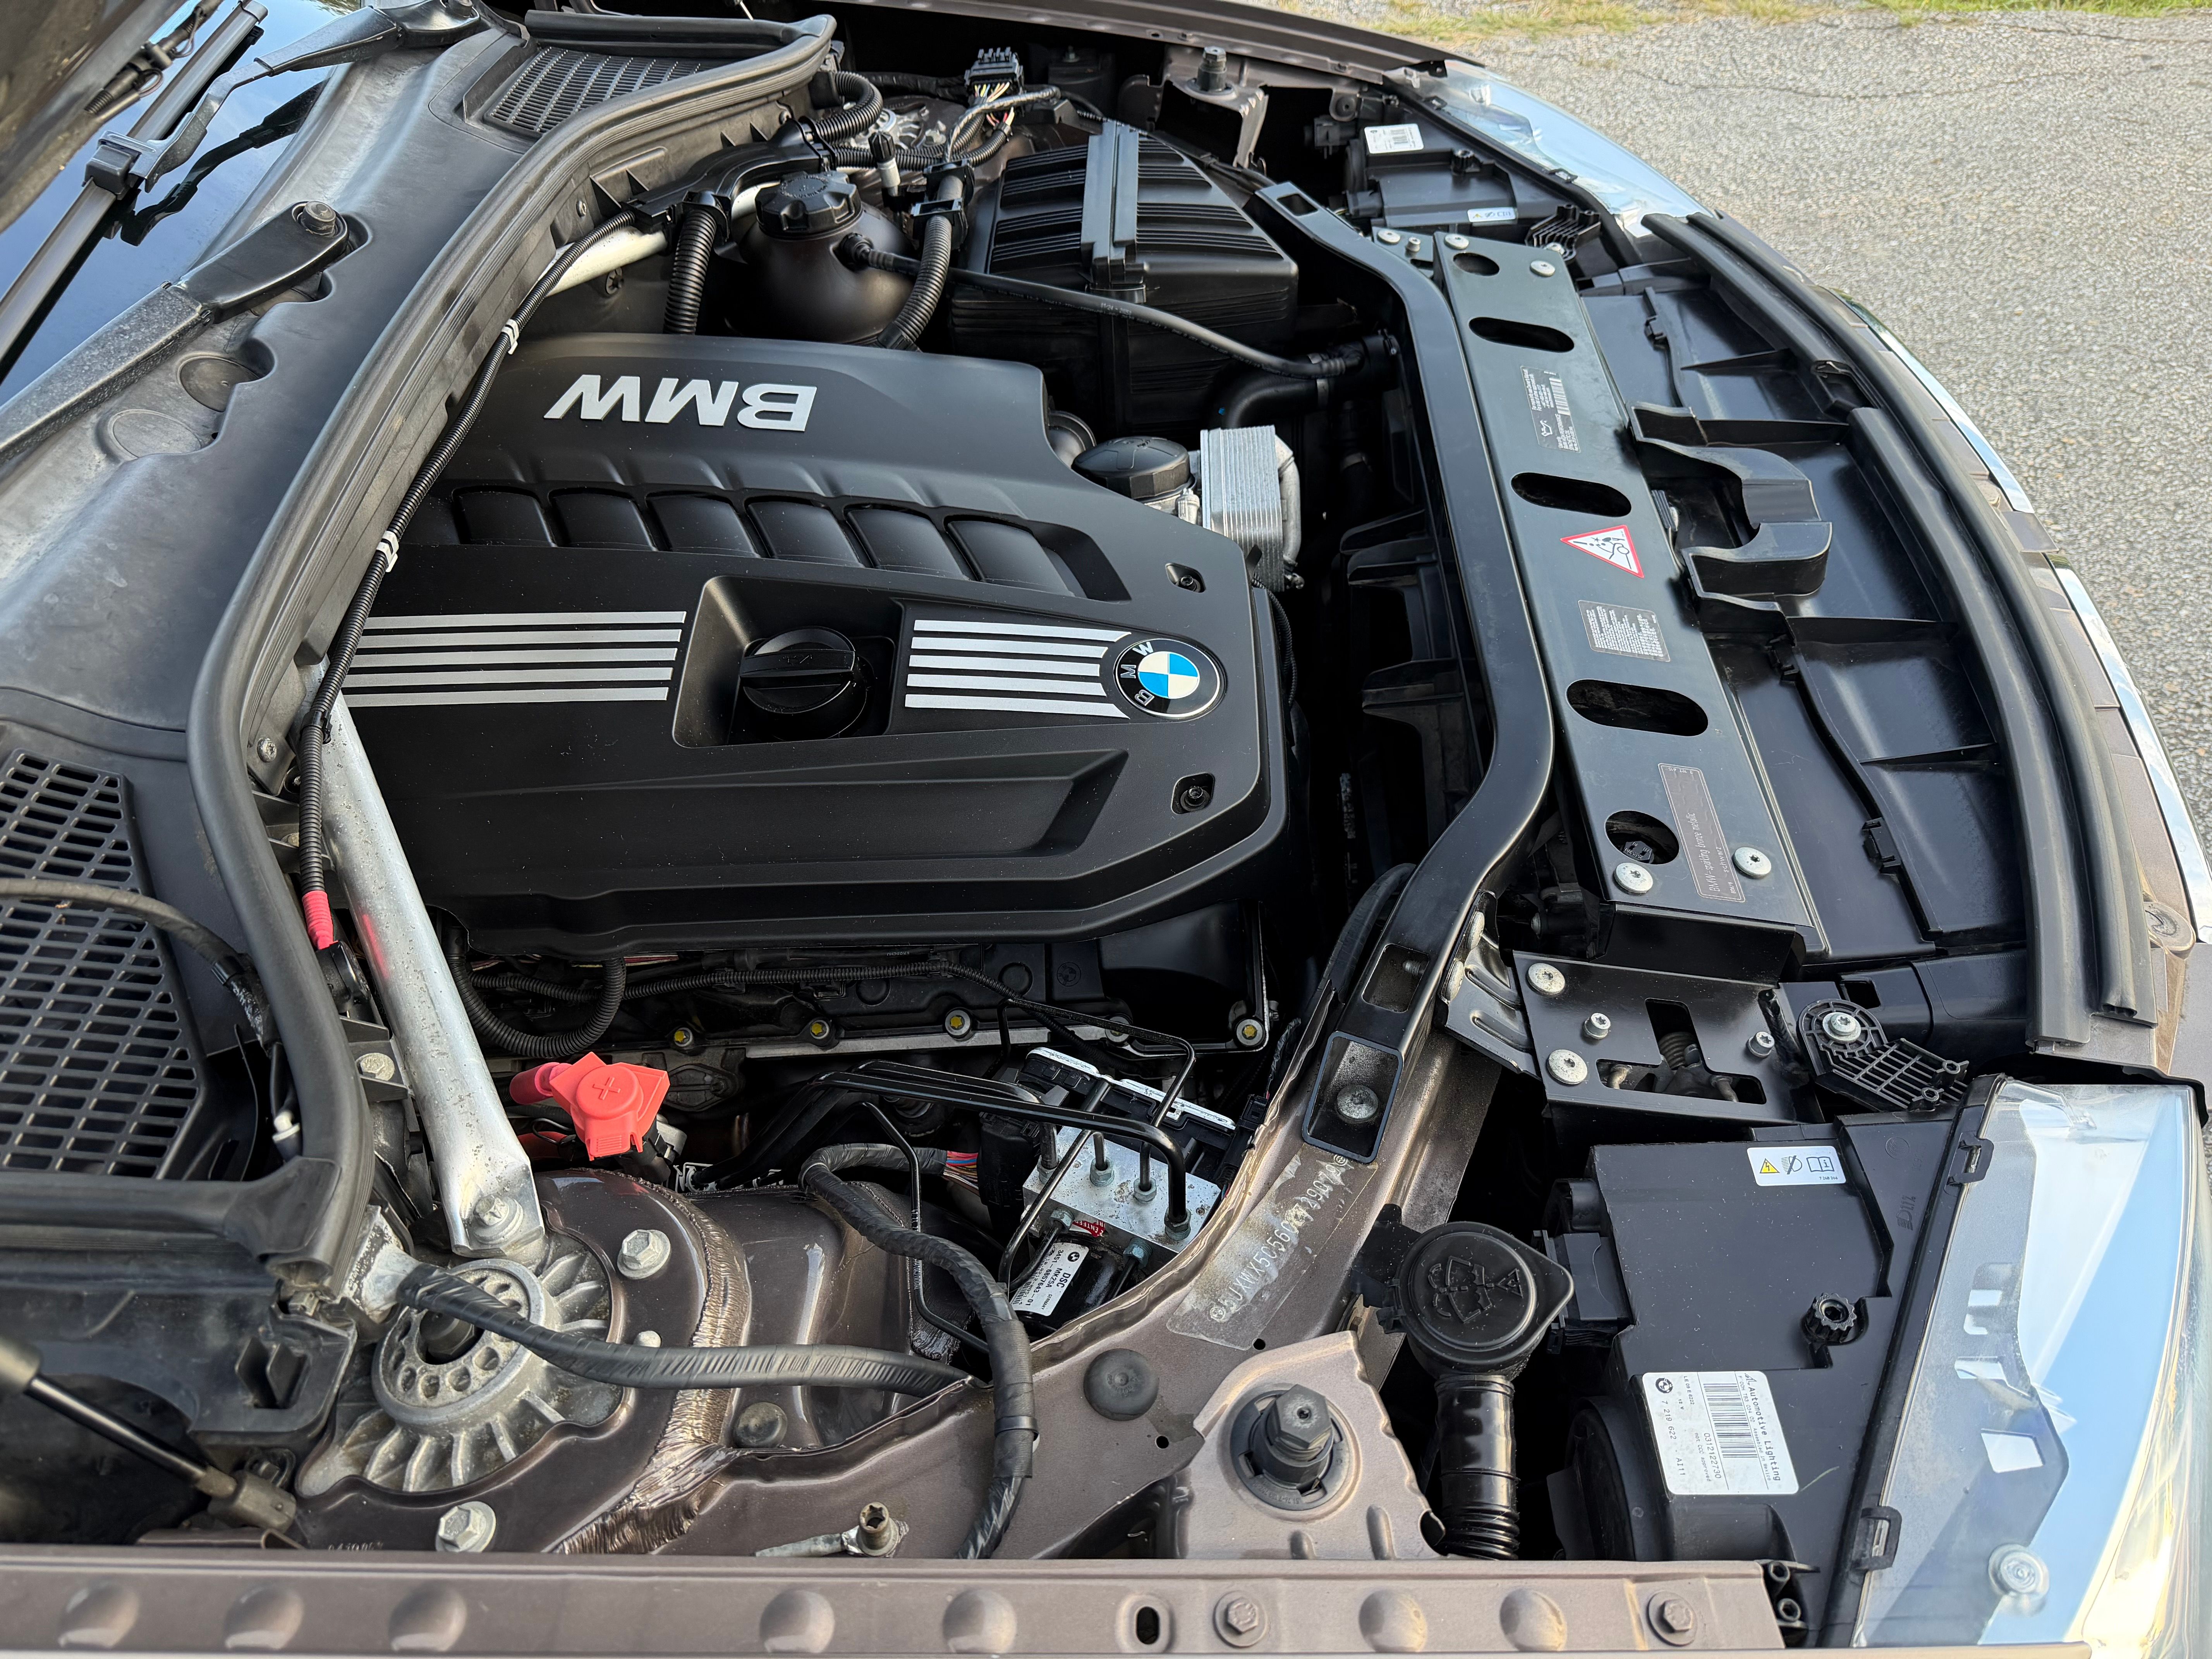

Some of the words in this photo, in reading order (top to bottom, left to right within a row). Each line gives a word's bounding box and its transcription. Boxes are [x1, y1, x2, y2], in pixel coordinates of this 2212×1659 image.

[544, 374, 817, 431] BMW
[1120, 642, 1155, 706] BMW
[1686, 812, 1700, 830] metallic
[1695, 832, 1706, 848] bronze
[1716, 847, 1729, 872] schwarz
[1046, 1268, 1063, 1288] MK25A
[1056, 1273, 1071, 1288] DSC
[1041, 1294, 1053, 1310] GERMANY
[1664, 1409, 1673, 1422] 219
[1668, 1426, 1677, 1440] 622
[1748, 1387, 1767, 1435] Automotive
[1764, 1441, 1781, 1480] Lighting
[1703, 1433, 1722, 1479] 0312122730
[1753, 1428, 1764, 1453] Assembled
[1763, 1464, 1772, 1480] Mexico
[1700, 1457, 1712, 1481] approved
